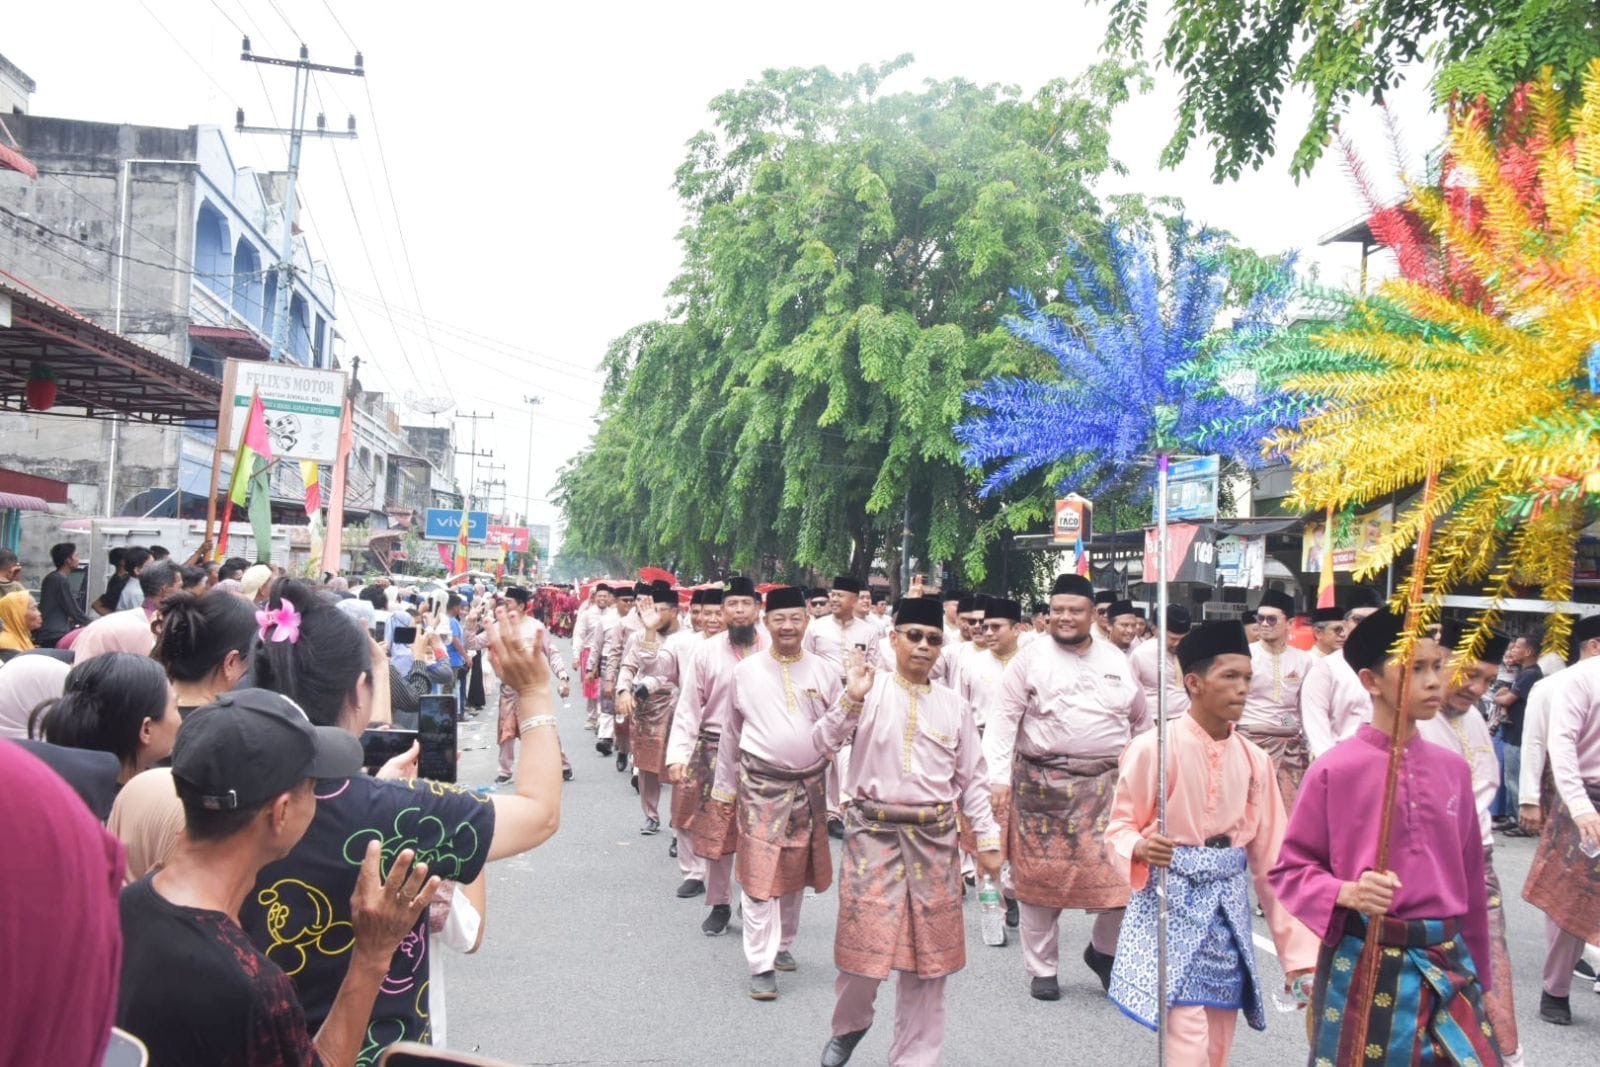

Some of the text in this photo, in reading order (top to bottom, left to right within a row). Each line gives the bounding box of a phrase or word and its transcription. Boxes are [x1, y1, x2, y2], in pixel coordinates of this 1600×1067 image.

[246, 372, 335, 394] FELIX'S MOTOR
[436, 516, 477, 528] vivo
[1059, 517, 1079, 526] TACO
